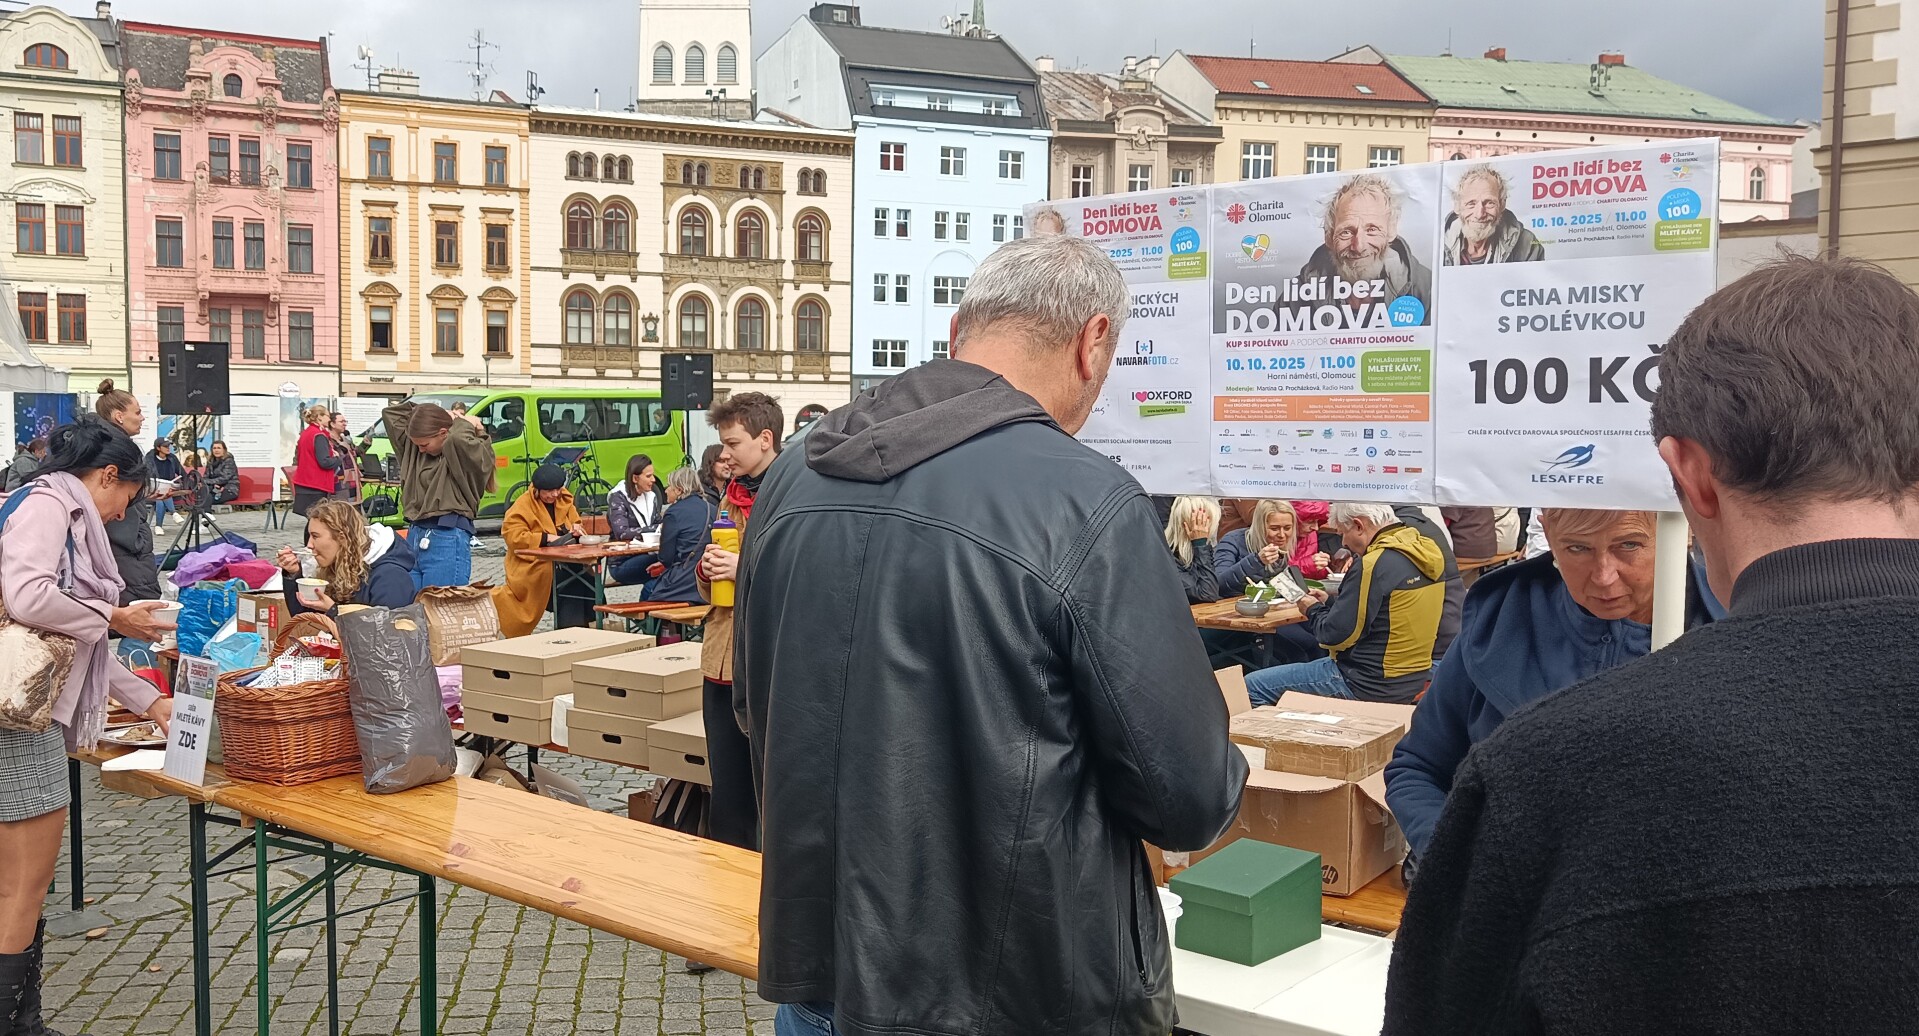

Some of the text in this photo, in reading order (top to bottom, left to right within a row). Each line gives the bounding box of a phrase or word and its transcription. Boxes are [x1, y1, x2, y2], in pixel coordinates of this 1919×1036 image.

[1532, 159, 1642, 179] Den lidí bez
[1532, 174, 1647, 200] DOMOVA
[1083, 202, 1158, 219] Den lidí bez
[1249, 200, 1284, 211] Charita
[1666, 204, 1690, 218] 100
[1249, 213, 1292, 222] Olomouc
[1532, 218, 1548, 228] 10.
[1551, 217, 1567, 227] 10.
[1571, 214, 1602, 225] 2025
[1615, 211, 1646, 222] 11.00
[1083, 216, 1163, 236] DOMOVA
[1110, 246, 1163, 258] 2025 11.00
[1176, 240, 1193, 252] 100
[1226, 275, 1385, 305] Den lidí bez
[1500, 284, 1645, 307] CENA MISKY
[1132, 291, 1179, 305] ICKÝCH
[1226, 302, 1393, 334] DOMOVA
[1394, 312, 1414, 323] 100
[1498, 310, 1645, 333] S POLÉVKOU
[1252, 338, 1288, 347] POLÉVKU
[1330, 336, 1366, 345] CHARITU
[1368, 335, 1414, 344] OLOMOUC
[1226, 359, 1244, 370] 10.
[1248, 358, 1266, 370] 10.
[1270, 357, 1305, 370] 2025
[1320, 356, 1355, 369] 11.00
[1368, 363, 1422, 372] MLETÉ KÁVY,
[1468, 357, 1569, 404] 100
[1147, 391, 1192, 400] OXFORD
[1531, 474, 1604, 484] LESAFFRE
[463, 616, 477, 625] dm
[176, 712, 205, 727] MLETÉ KÁVY
[178, 730, 197, 750] ZDE
